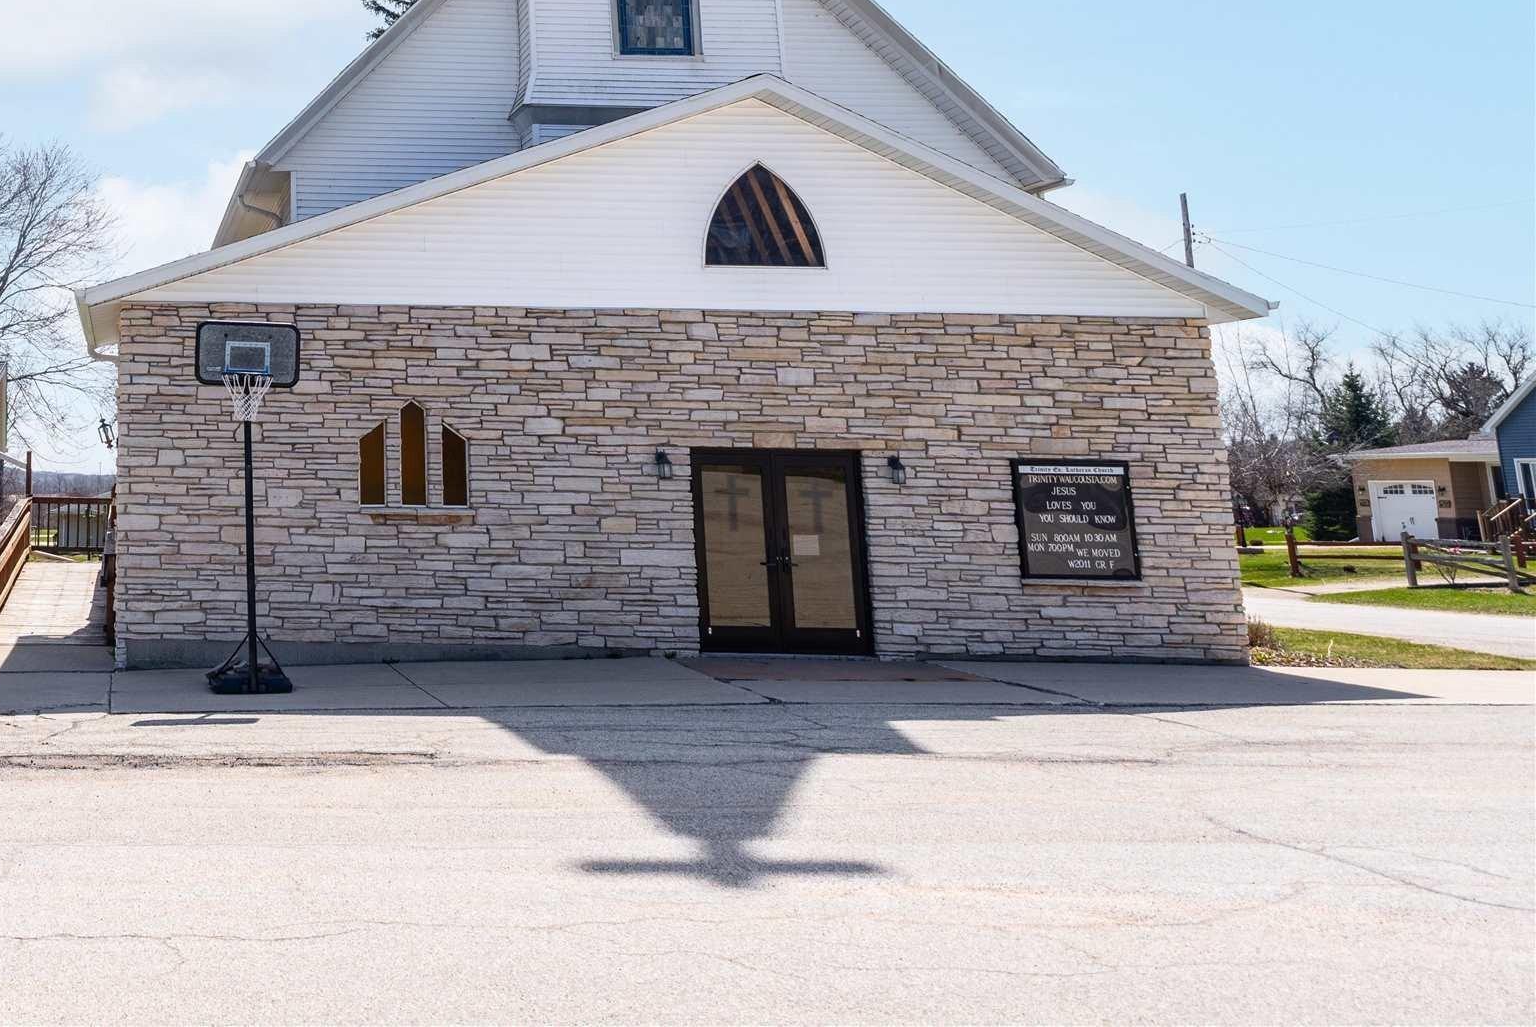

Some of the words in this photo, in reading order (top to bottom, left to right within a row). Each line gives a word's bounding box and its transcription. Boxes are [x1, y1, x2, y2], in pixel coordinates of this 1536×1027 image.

[1051, 486, 1076, 496] JESUS
[1046, 501, 1072, 510] LOVES
[1080, 501, 1096, 510] YOU
[1039, 513, 1054, 523] YOU
[1059, 514, 1089, 523] SHOULD
[1094, 515, 1116, 524] KNOW
[1030, 532, 1048, 542] SUN
[1027, 542, 1045, 552] MON
[1076, 548, 1089, 557] WE
[1091, 548, 1121, 558] MOVED
[1095, 560, 1106, 569] CR
